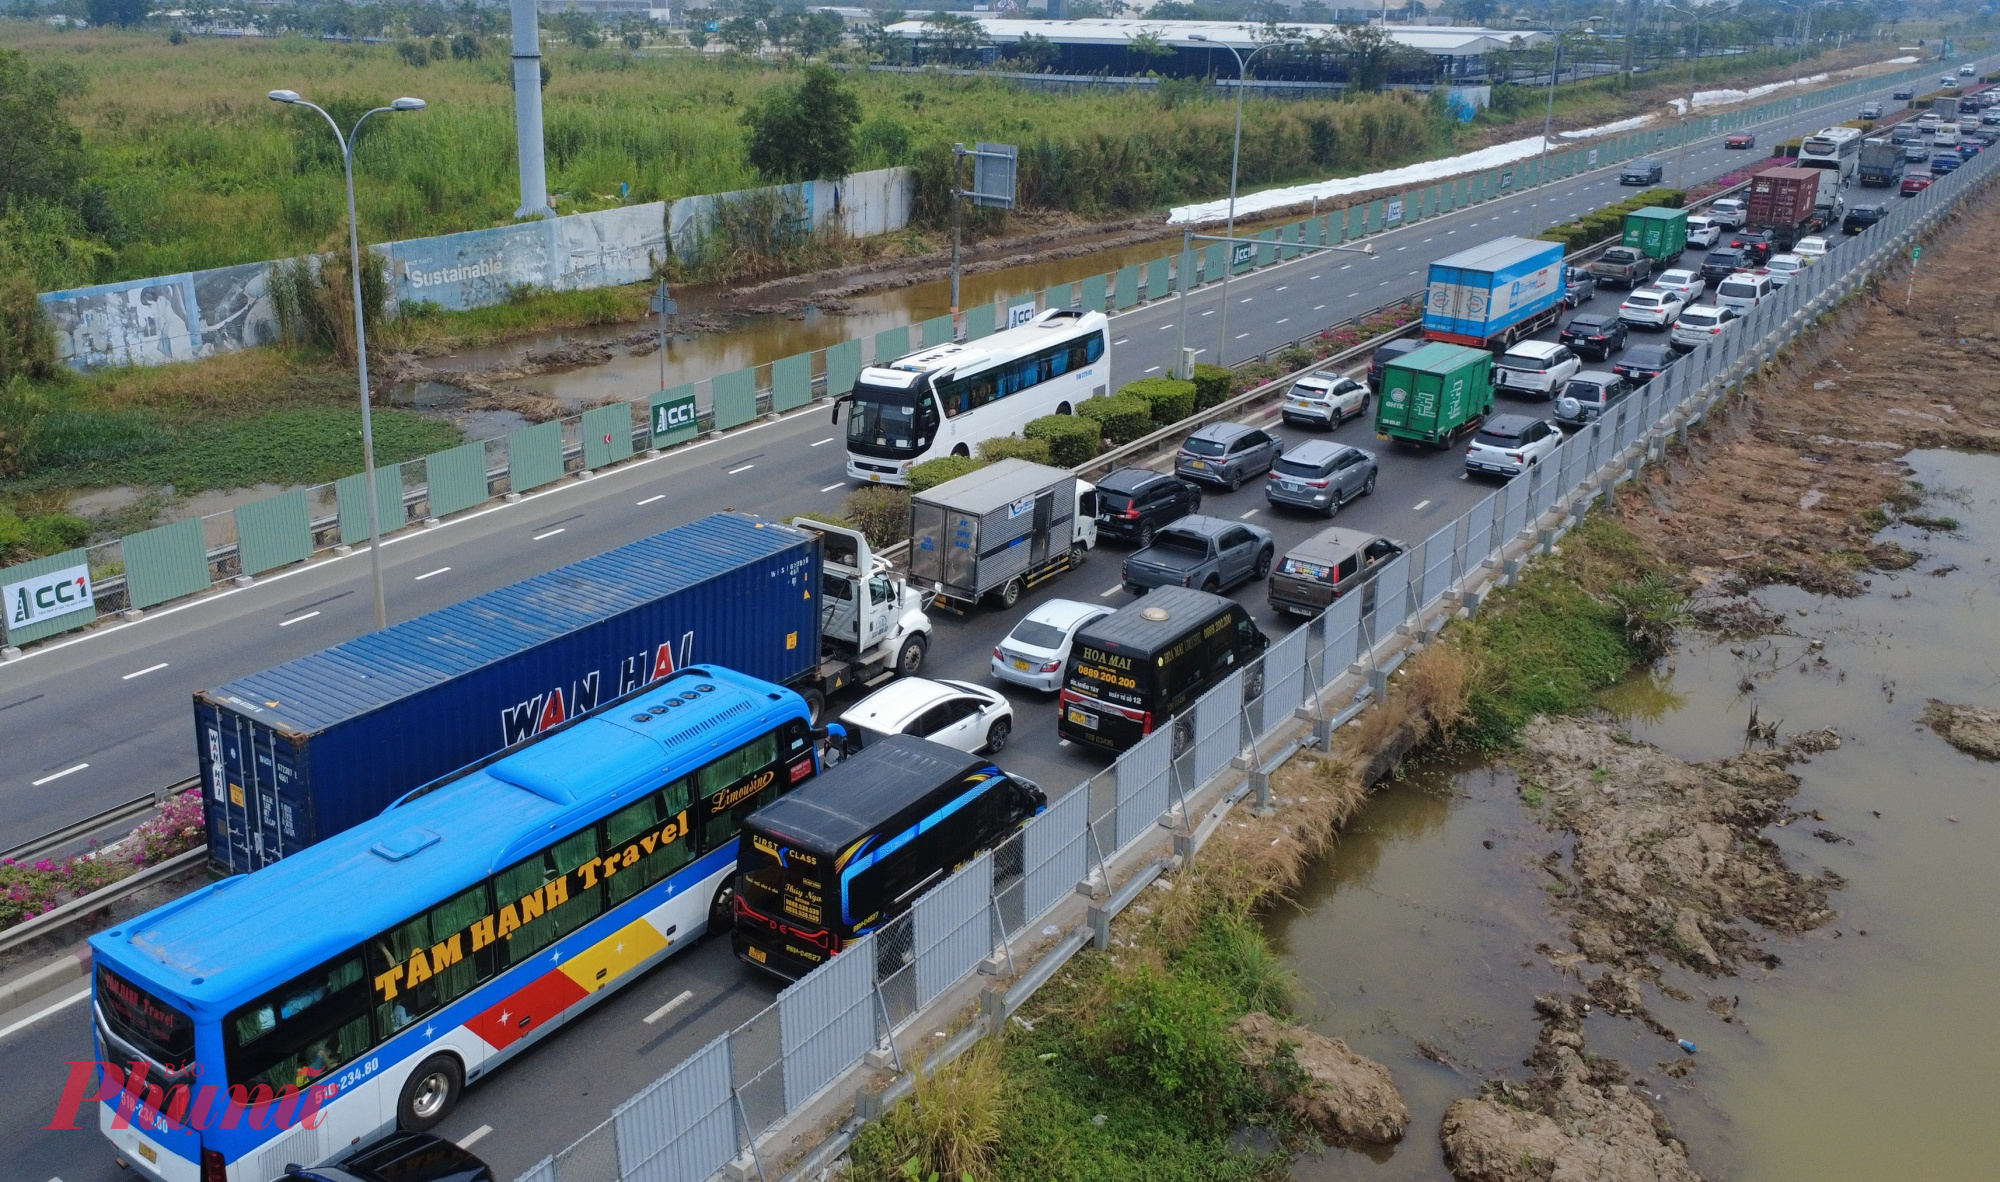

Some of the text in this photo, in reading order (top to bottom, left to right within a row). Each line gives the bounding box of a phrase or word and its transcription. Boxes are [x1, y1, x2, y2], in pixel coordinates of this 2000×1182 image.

[411, 258, 503, 289] Sustainable
[1083, 646, 1132, 671] HOA MAI
[502, 631, 694, 748] WAN HAI
[1078, 665, 1136, 689] 0889.200.200
[1132, 696, 1142, 704] 12
[210, 732, 222, 798] WAN HAI
[711, 771, 774, 814] Limousine
[753, 835, 779, 850] FIRST
[788, 849, 817, 865] CLASS
[375, 809, 690, 1002] TÂM HẠNH Travel
[784, 883, 803, 898] Thúy
[804, 891, 823, 903] Nga
[143, 997, 175, 1029] Travel
[314, 1057, 379, 1106] 51B-234.80
[120, 1090, 169, 1135] 51B-234.80
